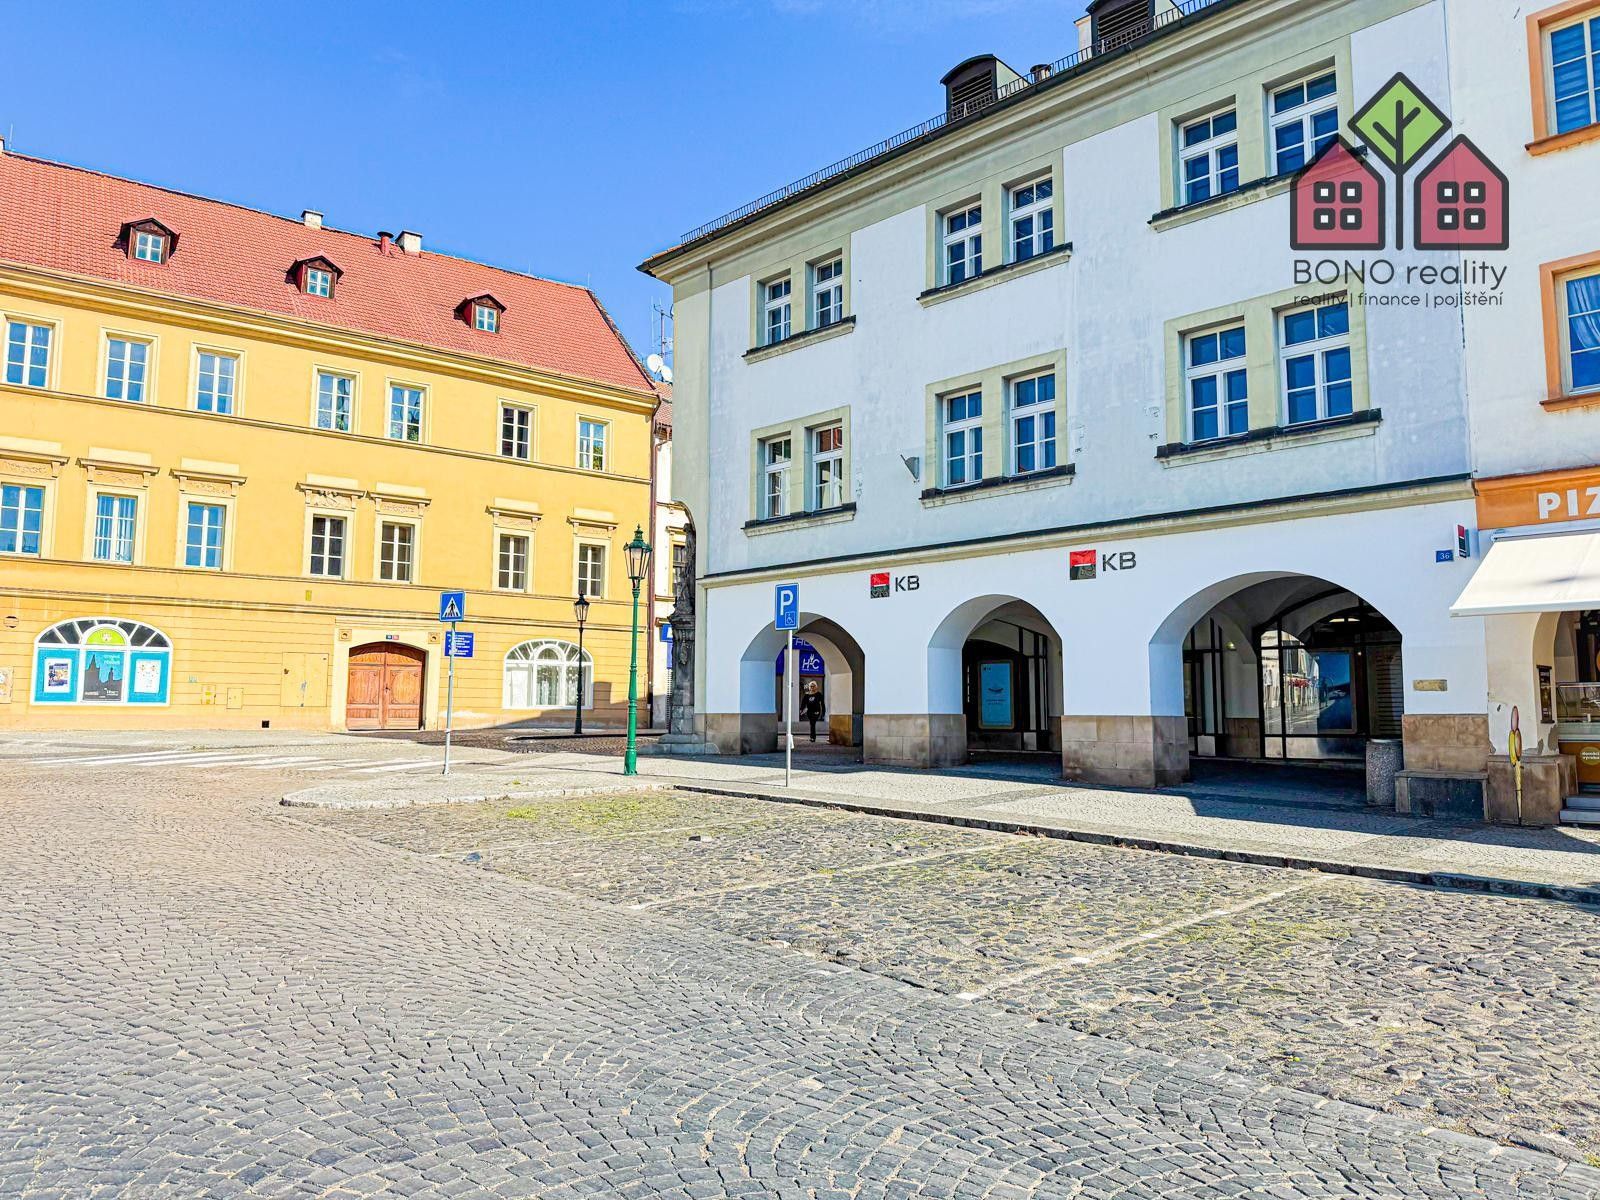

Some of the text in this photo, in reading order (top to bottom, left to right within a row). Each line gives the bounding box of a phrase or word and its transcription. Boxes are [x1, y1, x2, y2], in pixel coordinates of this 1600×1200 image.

[1102, 551, 1137, 572] KB
[895, 575, 920, 592] KB
[779, 589, 794, 616] P
